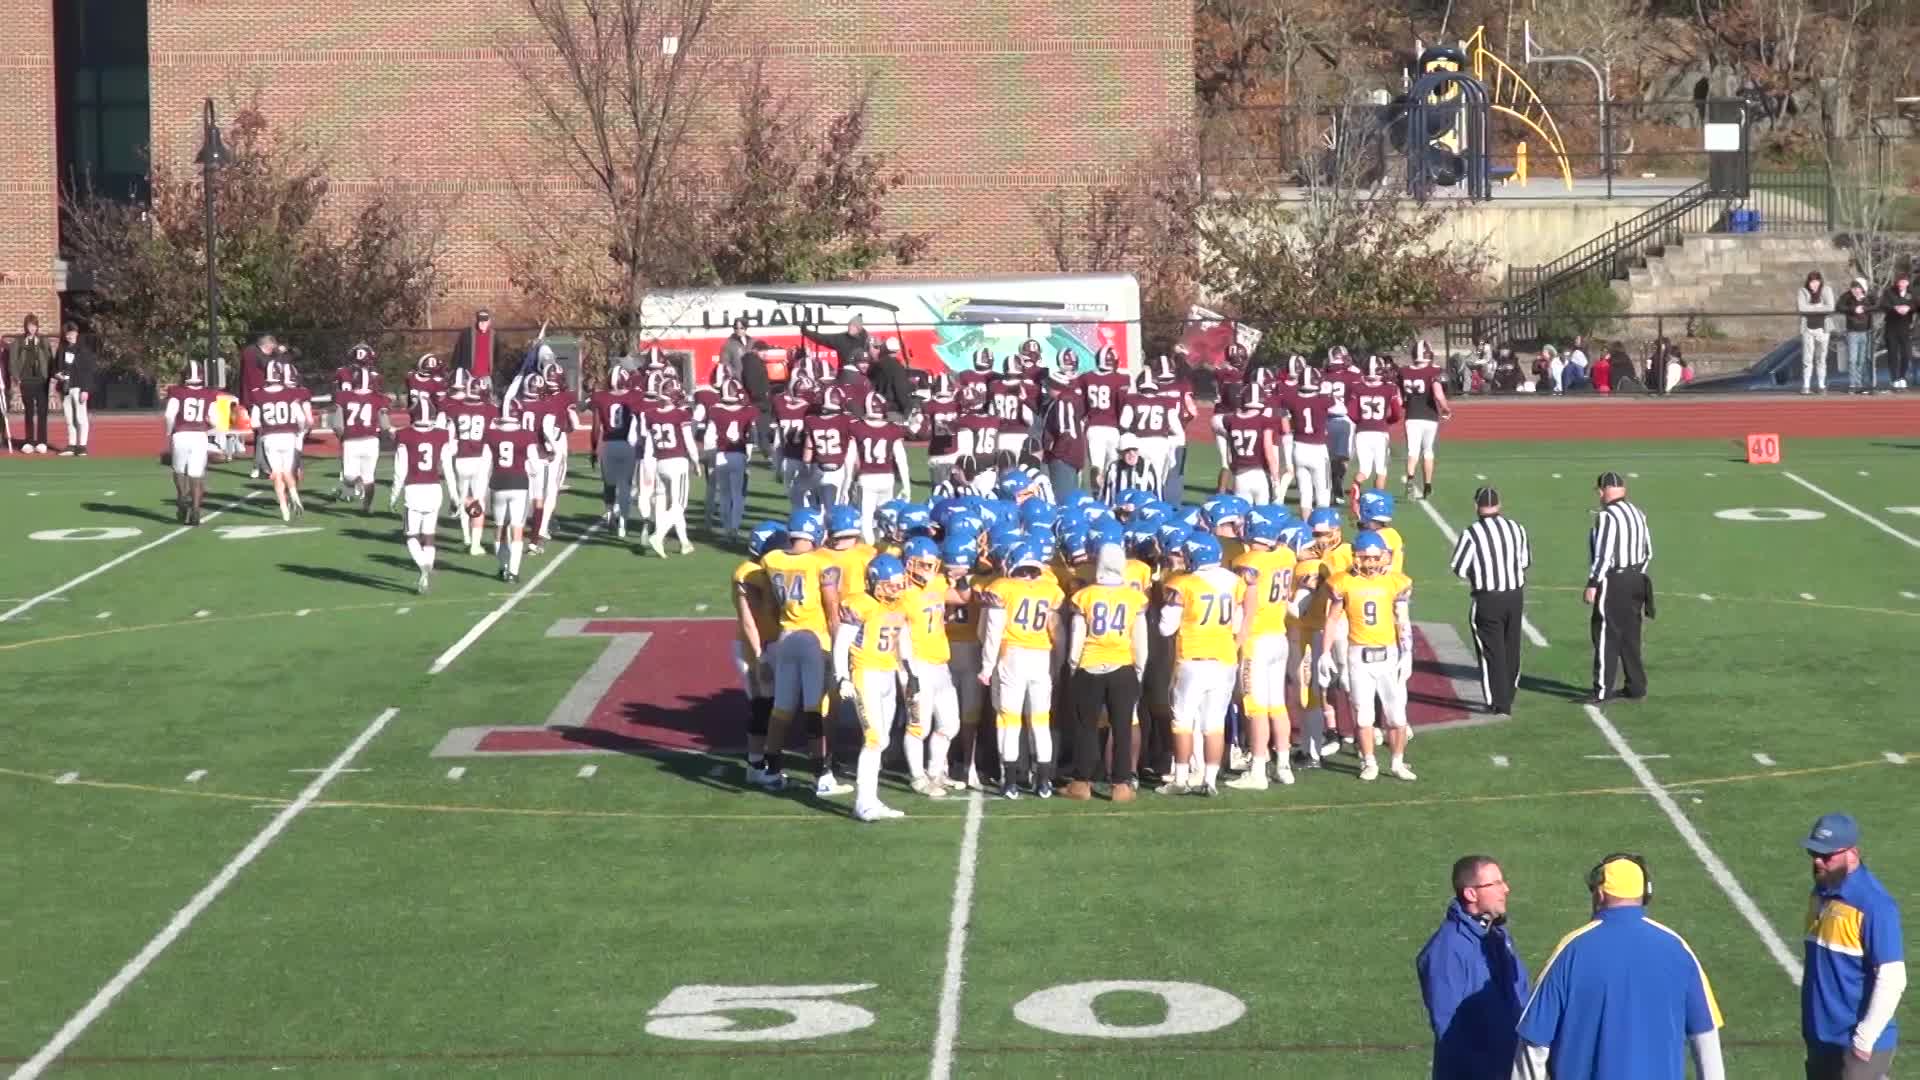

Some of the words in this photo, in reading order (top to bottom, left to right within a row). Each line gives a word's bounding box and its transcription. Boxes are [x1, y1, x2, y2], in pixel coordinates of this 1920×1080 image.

[702, 305, 836, 329] UHAUL
[183, 397, 205, 422] 61
[1087, 385, 1111, 410] 58
[1359, 396, 1386, 420] 53
[262, 401, 290, 424] 20
[346, 402, 372, 426] 74
[1137, 405, 1165, 430] 76
[1302, 408, 1314, 434] 1
[458, 413, 485, 440] 28
[651, 422, 677, 449] 23
[812, 428, 842, 454] 52
[862, 438, 887, 464] 14
[1231, 429, 1258, 456] 27
[1750, 438, 1777, 457] 40
[417, 442, 433, 471] 3
[498, 441, 514, 468] 9
[1268, 569, 1295, 604] 69
[1014, 598, 1049, 632] 46
[1091, 600, 1126, 637] 84
[1199, 592, 1232, 626] 70
[1363, 600, 1378, 626] 9
